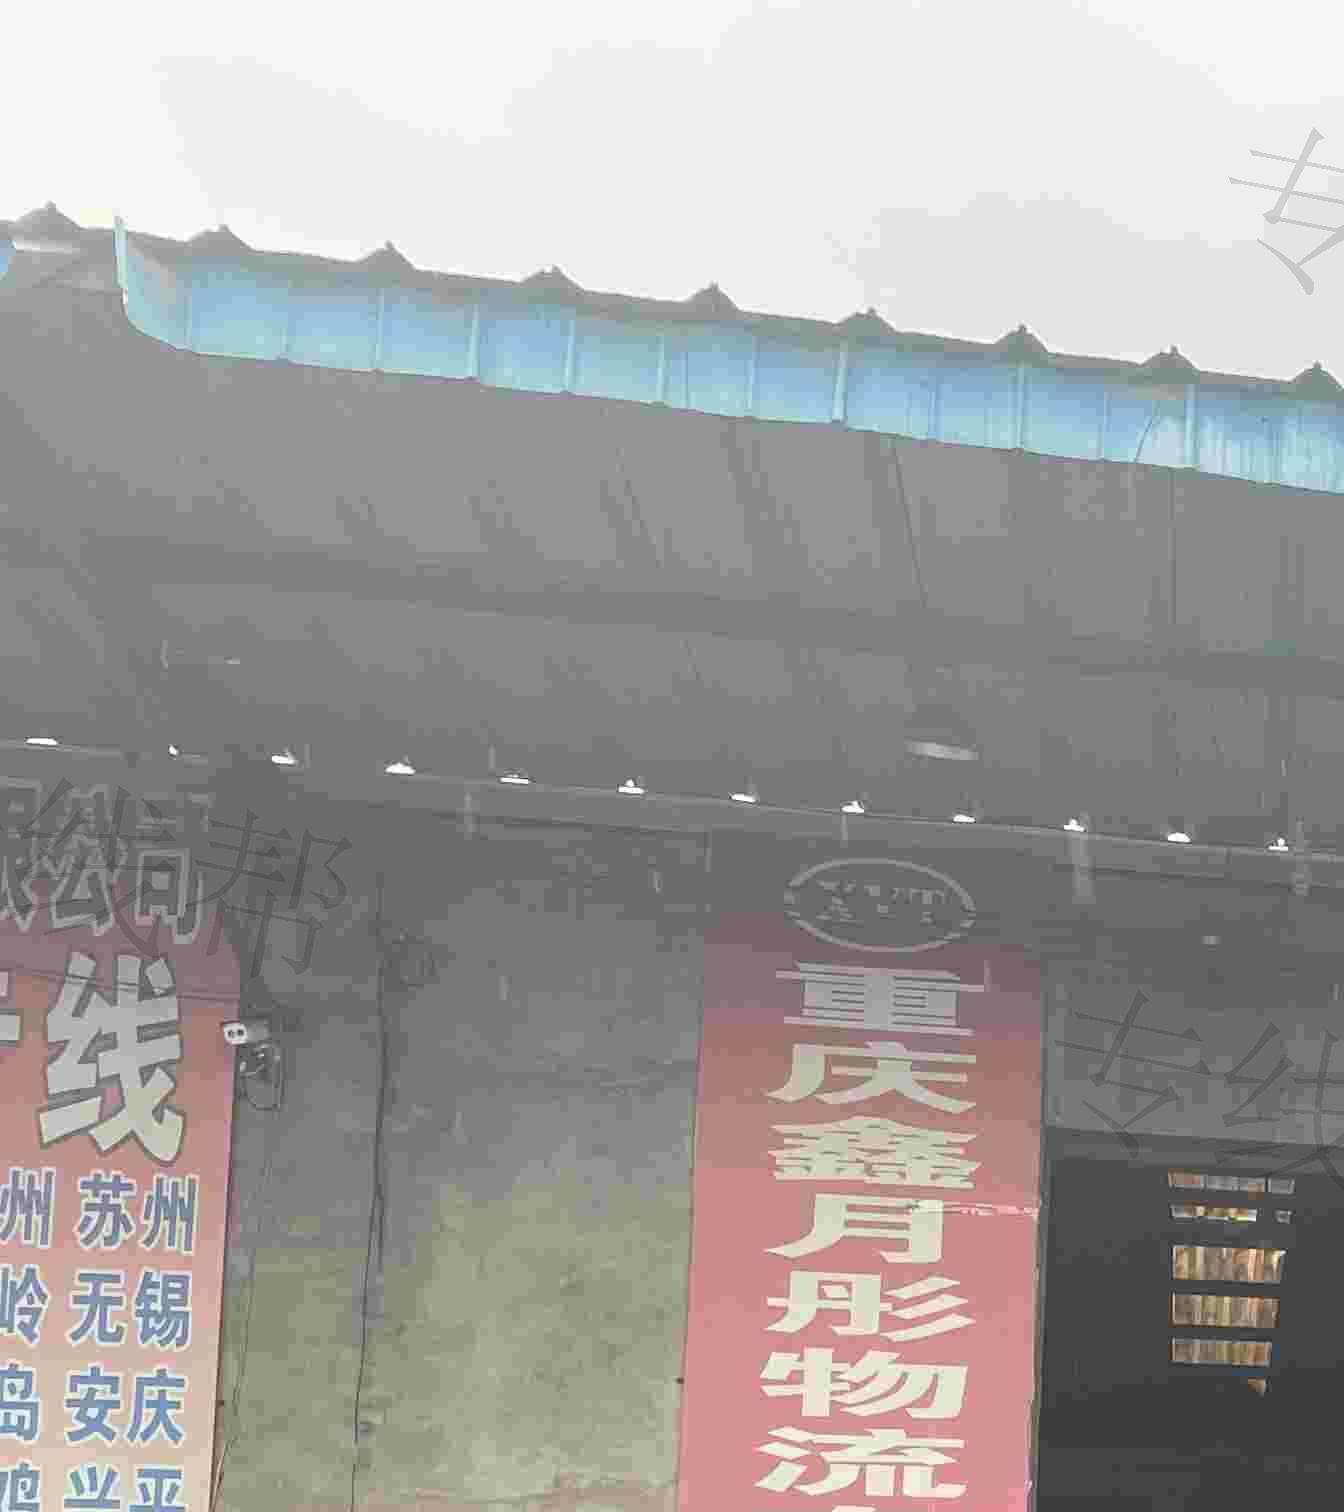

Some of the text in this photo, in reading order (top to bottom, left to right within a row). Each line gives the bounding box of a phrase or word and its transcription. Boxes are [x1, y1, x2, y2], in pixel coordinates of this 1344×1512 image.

[0, 952, 187, 1165] 线
[74, 1168, 200, 1256] 苏州
[65, 1267, 193, 1350] 无锡
[64, 1361, 189, 1445] 安庆
